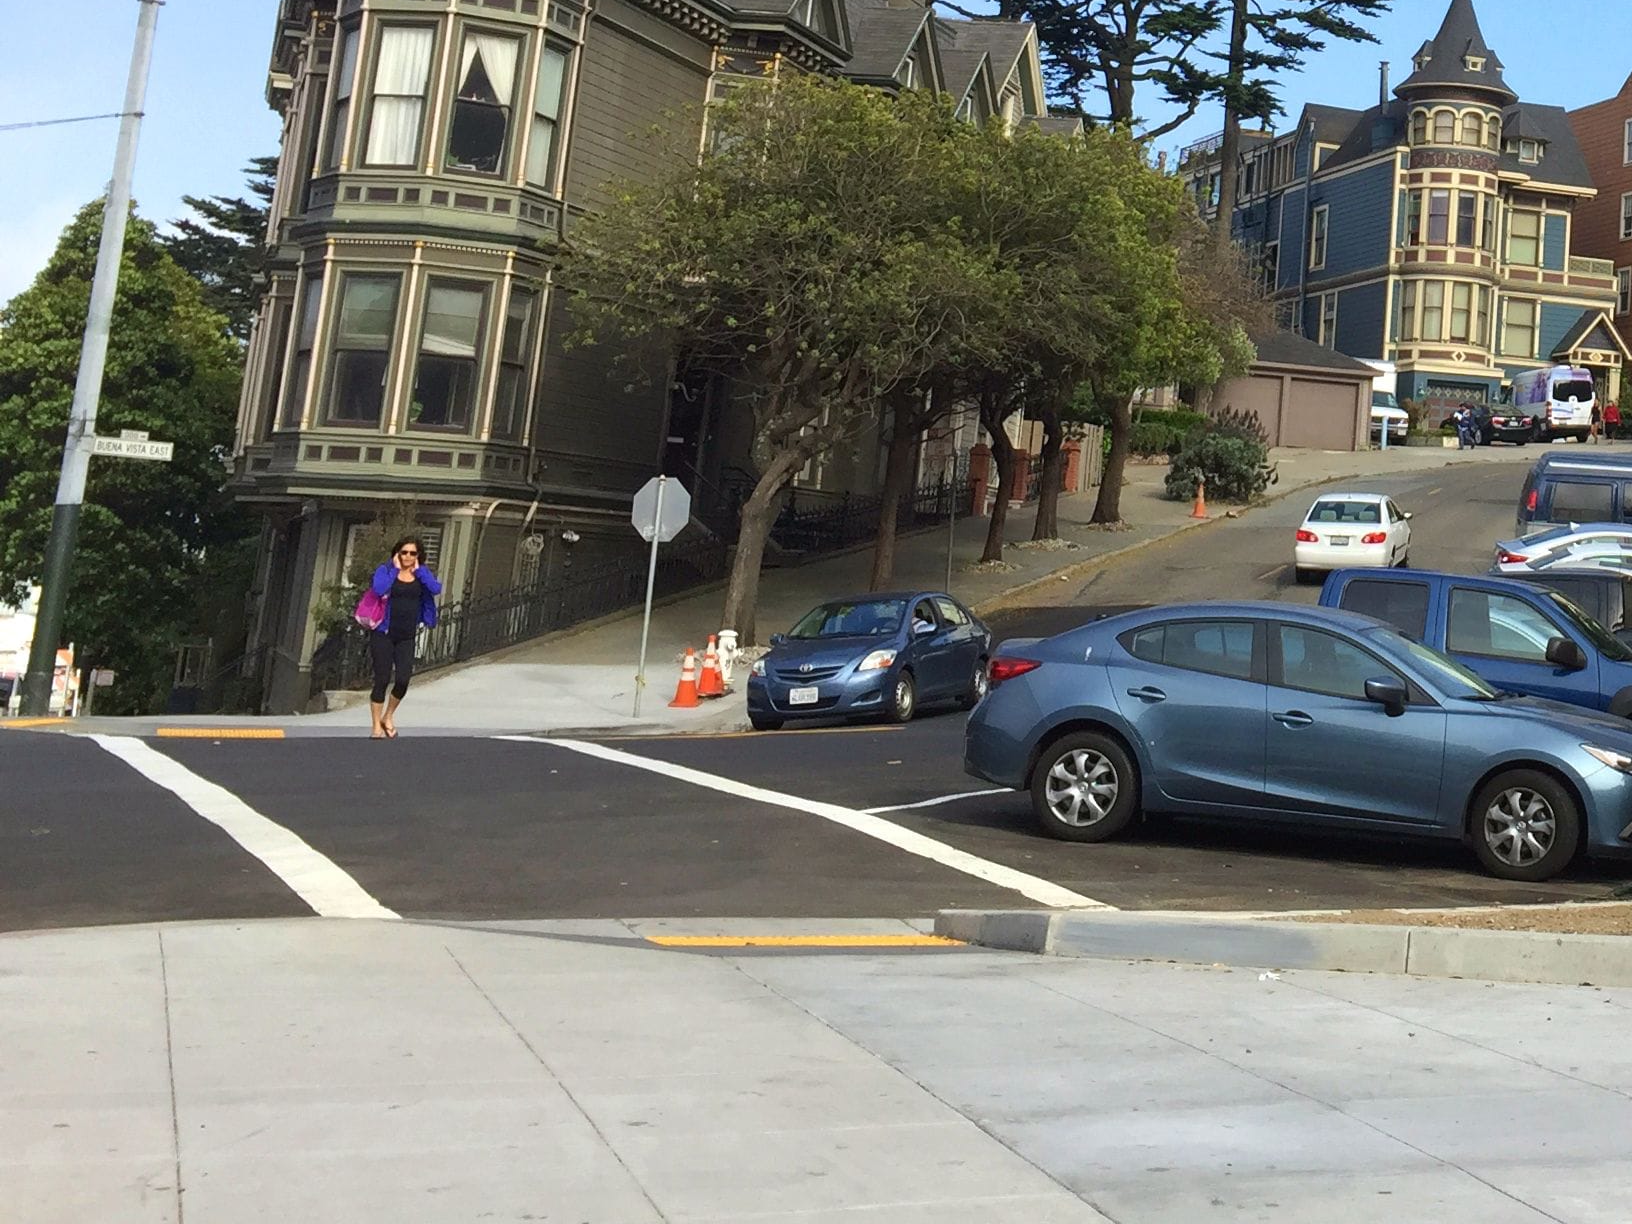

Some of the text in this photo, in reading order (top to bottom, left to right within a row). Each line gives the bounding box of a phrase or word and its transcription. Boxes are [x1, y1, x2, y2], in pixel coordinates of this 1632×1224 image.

[97, 440, 169, 456] BUENA VISTA EAST
